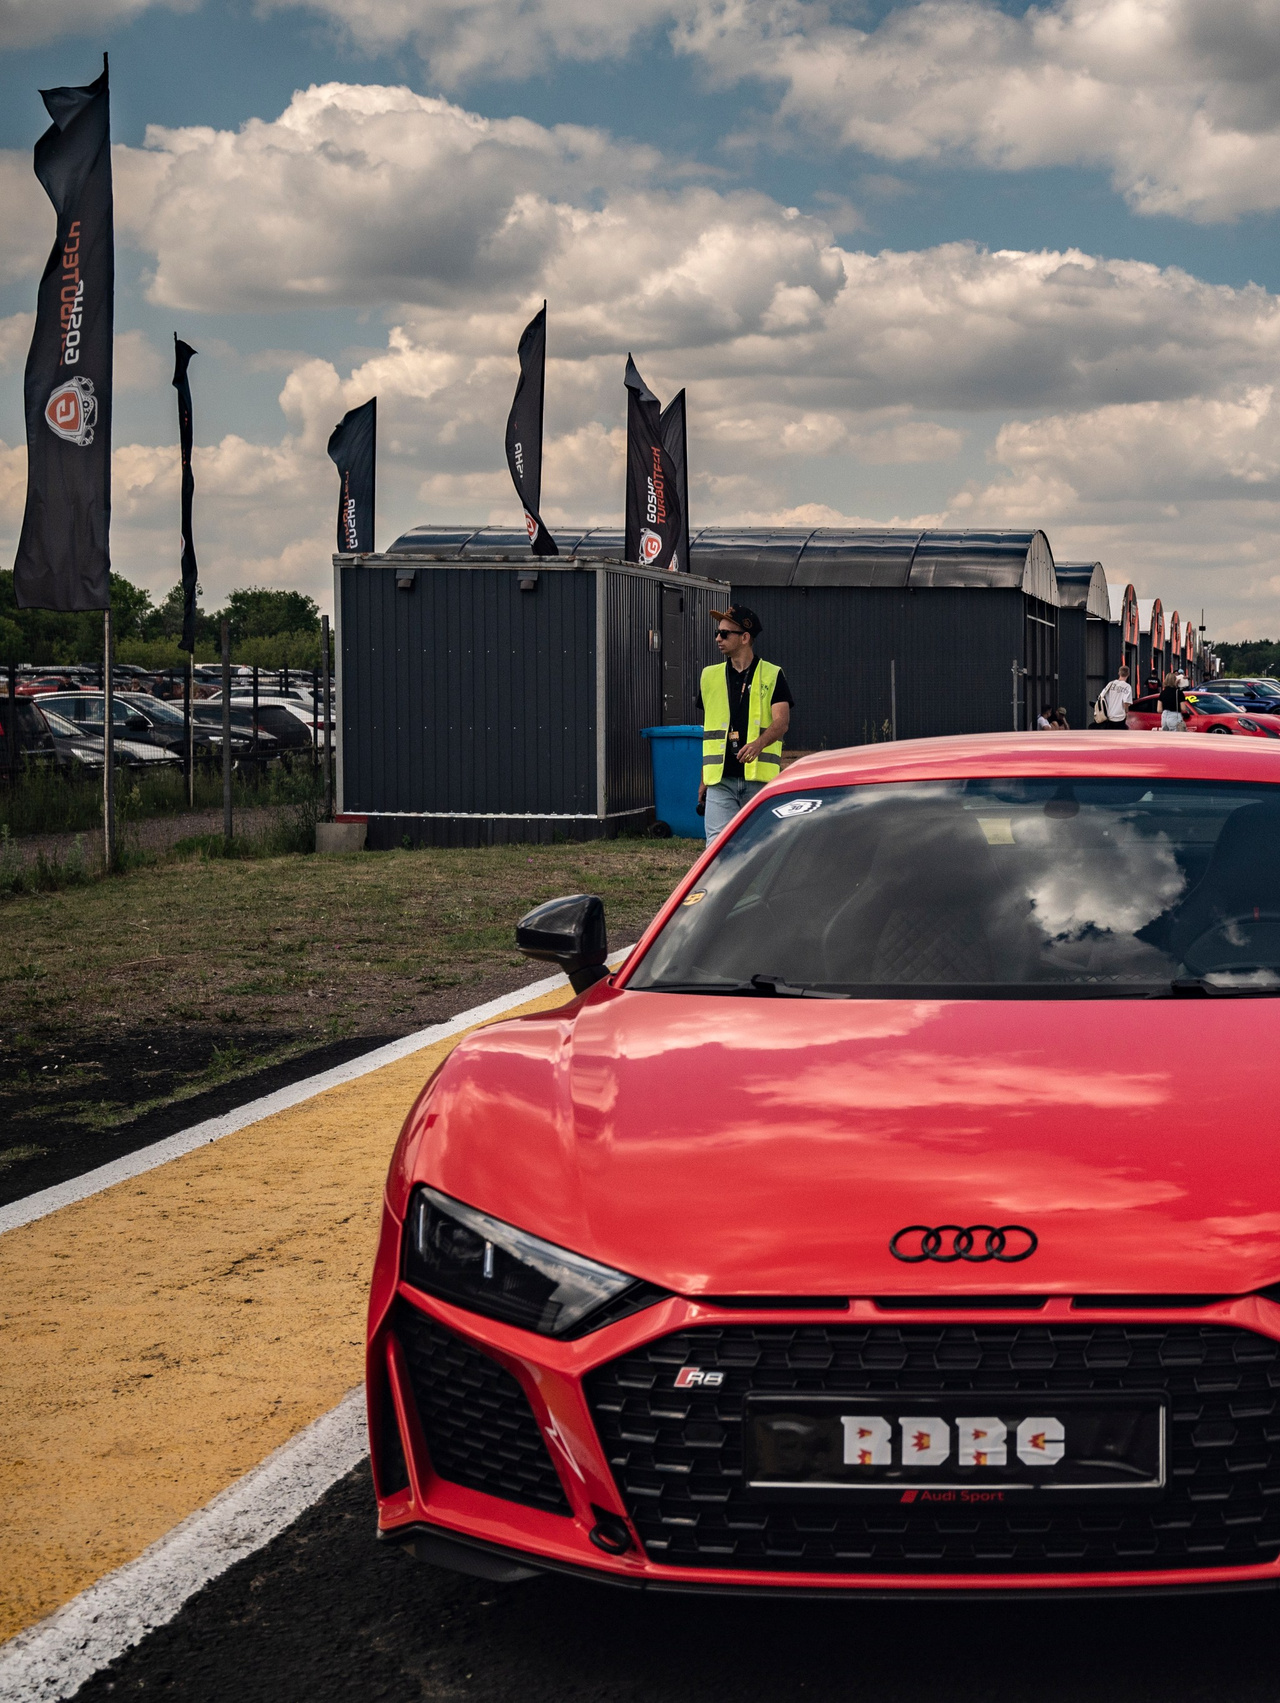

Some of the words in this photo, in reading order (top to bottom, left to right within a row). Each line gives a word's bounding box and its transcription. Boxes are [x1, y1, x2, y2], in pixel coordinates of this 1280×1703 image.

[686, 1369, 725, 1388] R8
[840, 1415, 1066, 1466] RDRC
[920, 1489, 957, 1501] Audi
[961, 1489, 1005, 1504] Sport
